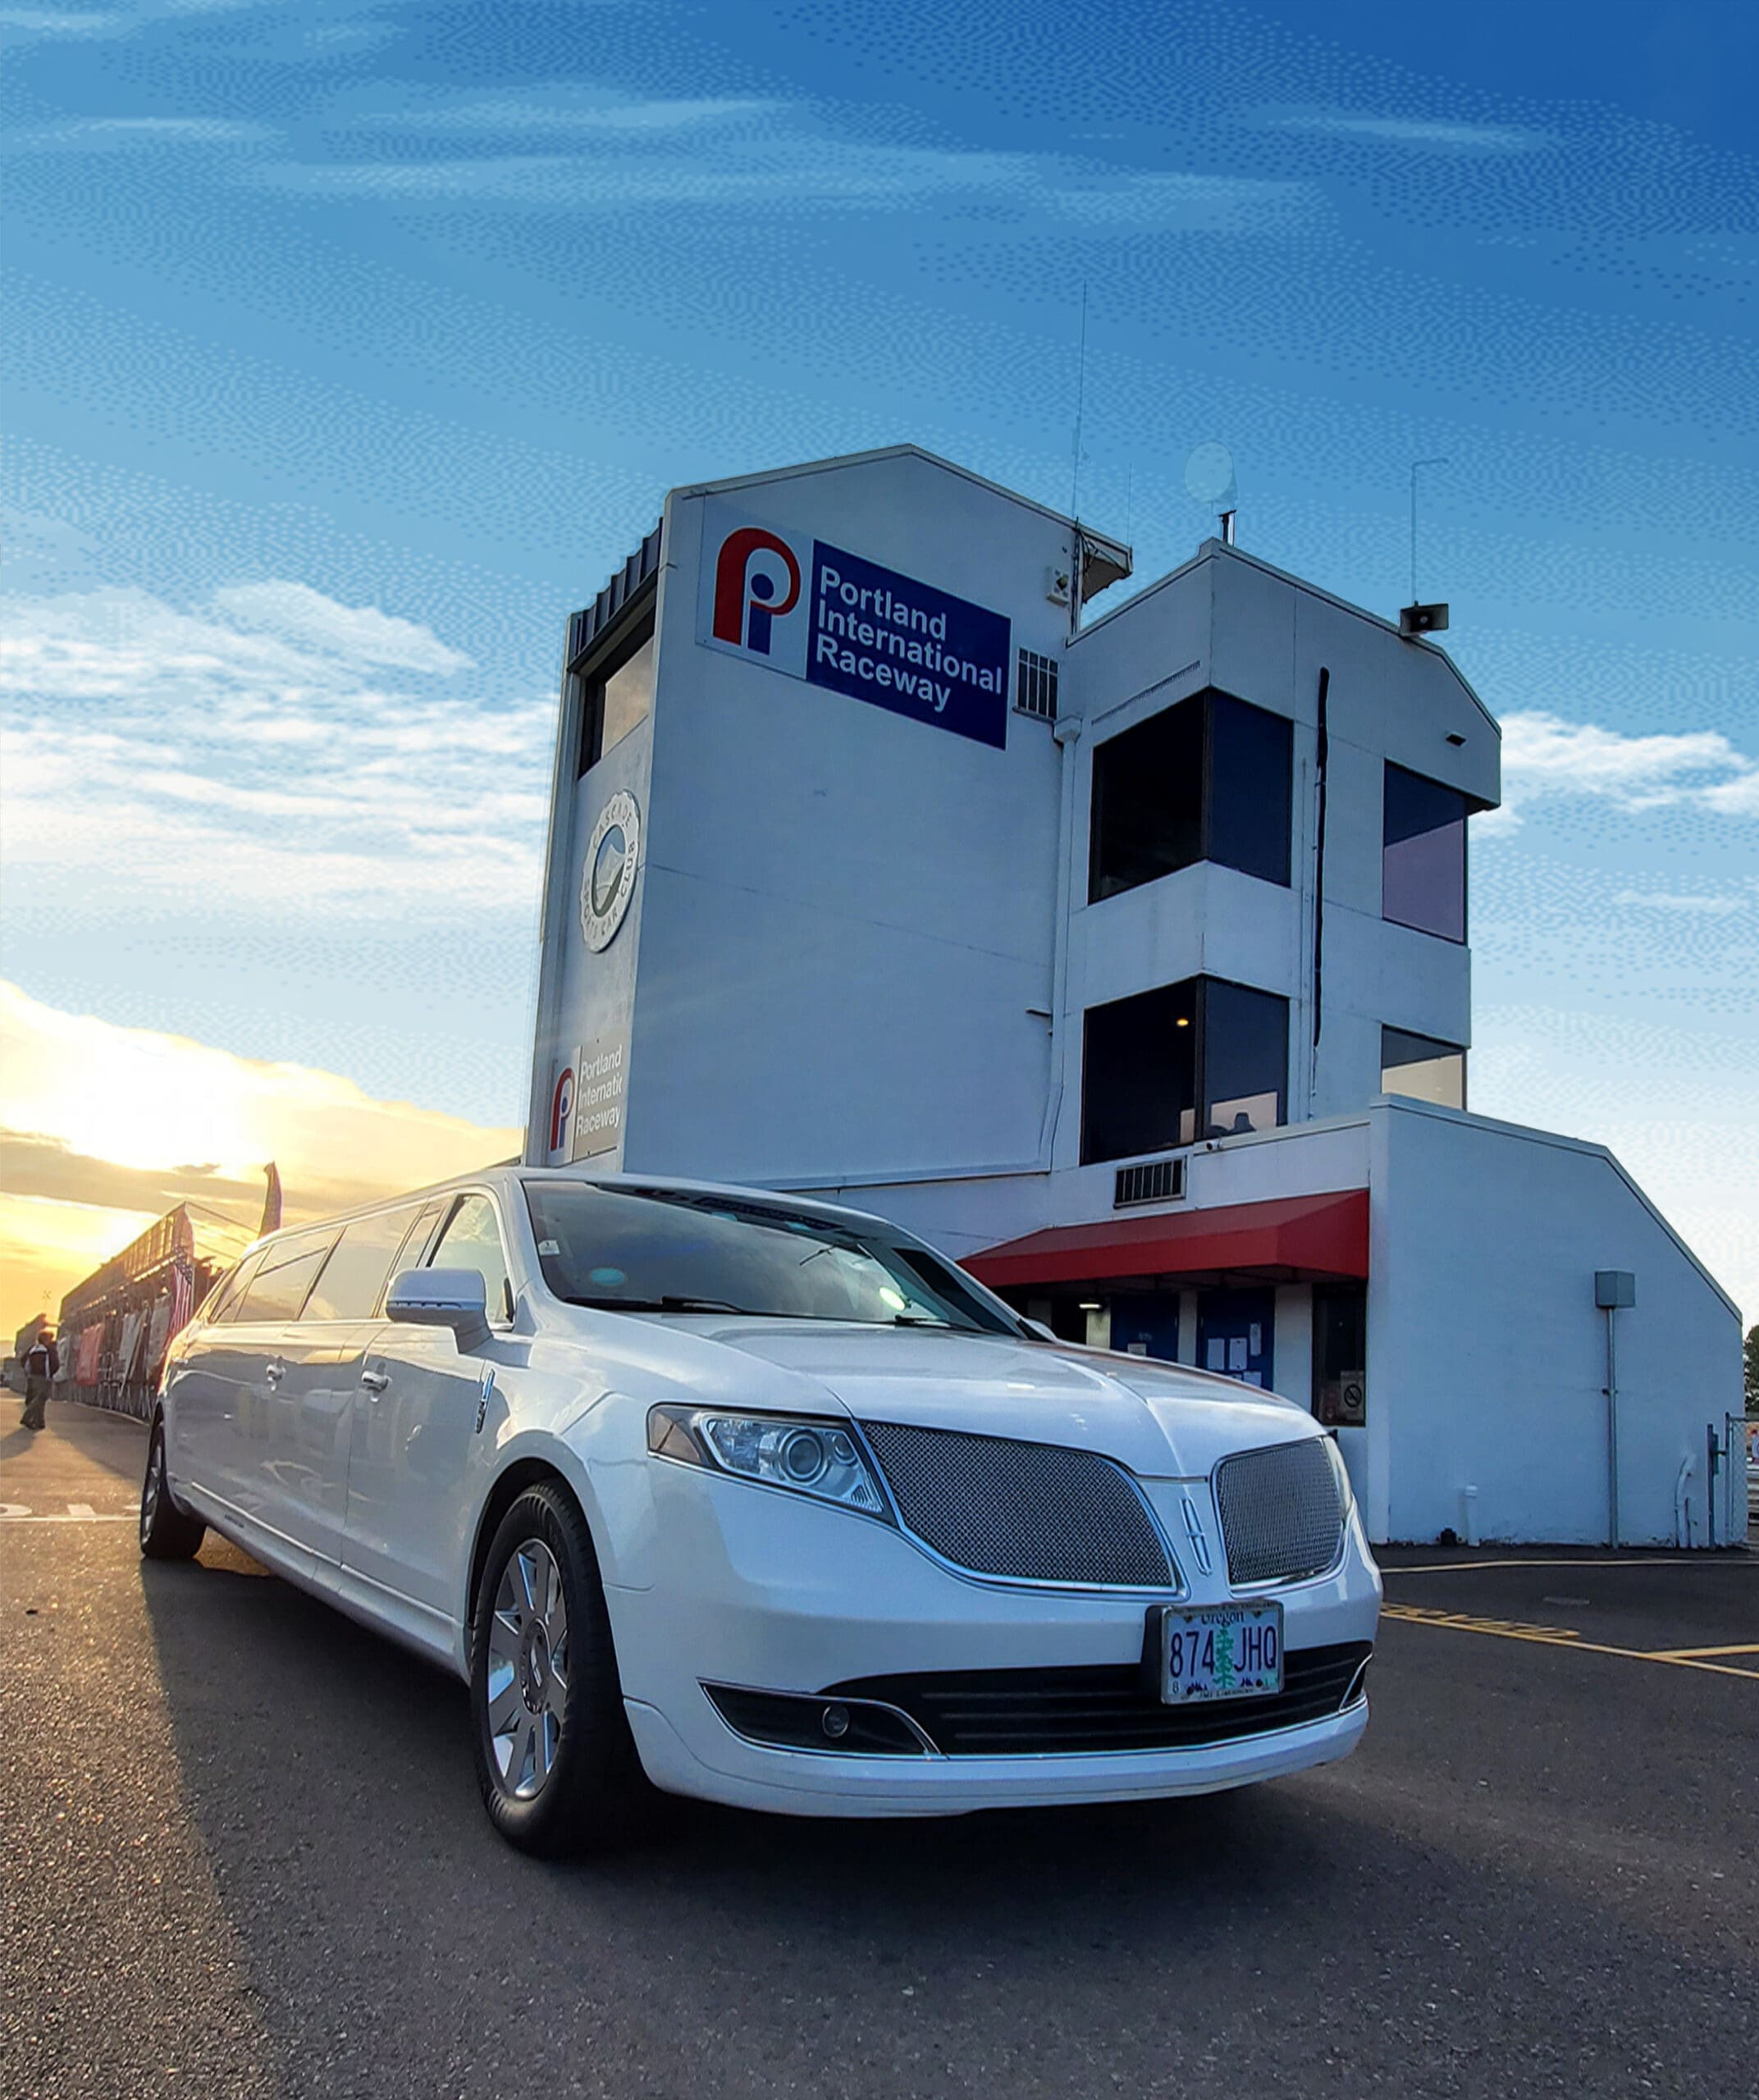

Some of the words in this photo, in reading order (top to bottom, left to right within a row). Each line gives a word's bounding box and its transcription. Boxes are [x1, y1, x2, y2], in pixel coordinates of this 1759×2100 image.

[821, 564, 947, 641] Portland
[816, 632, 951, 713] Raceway
[819, 600, 1003, 695] International
[593, 803, 633, 850] CASCADE
[601, 906, 619, 936] CAR
[620, 840, 635, 897] CLUB
[580, 1043, 622, 1084] Portland
[576, 1105, 621, 1137] Raceway
[1201, 1611, 1245, 1628] Oregon
[1170, 1631, 1214, 1678] 874
[1234, 1626, 1277, 1672] JHQ
